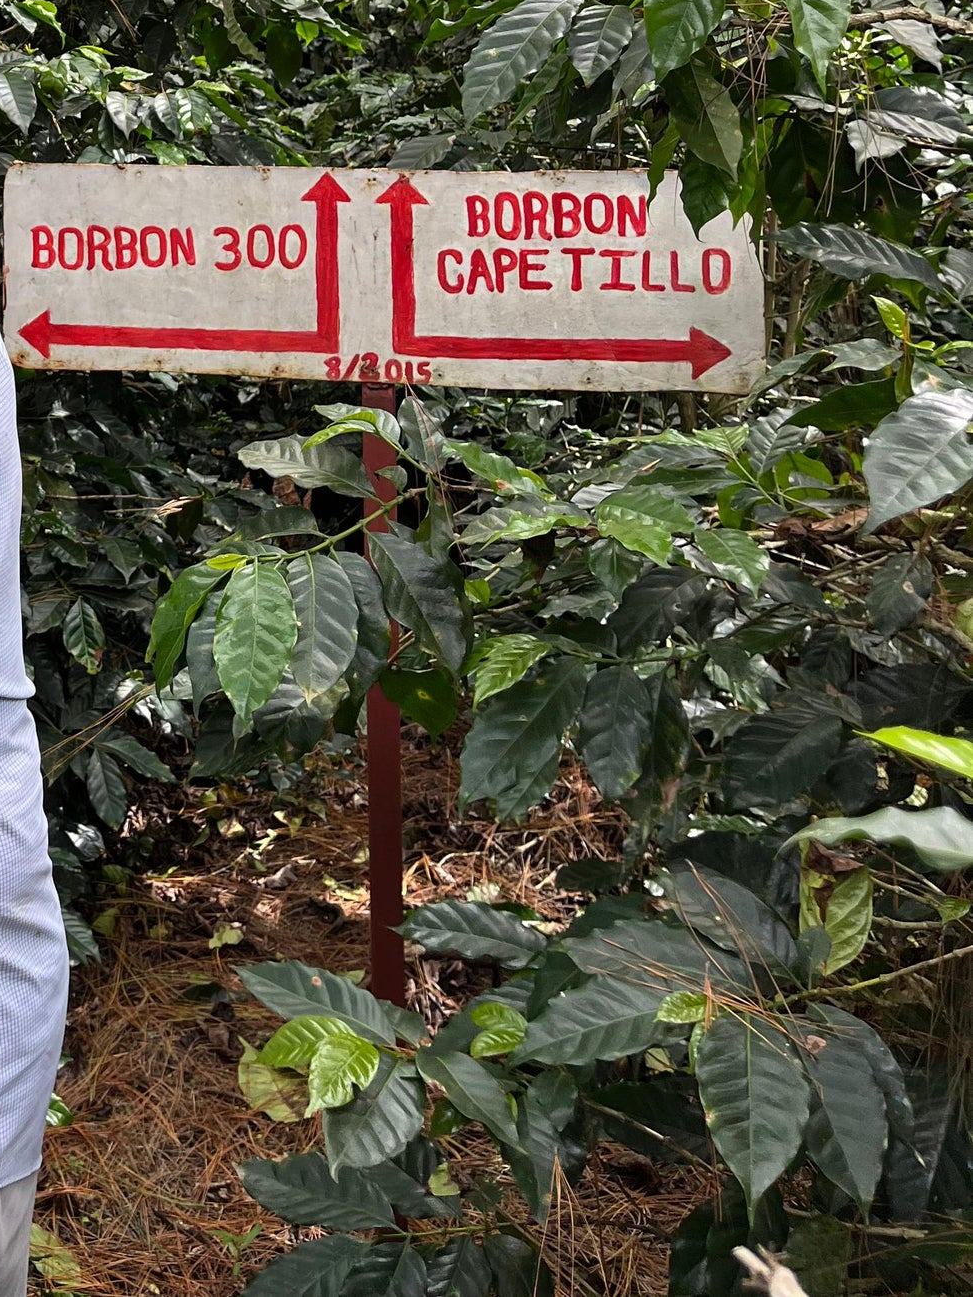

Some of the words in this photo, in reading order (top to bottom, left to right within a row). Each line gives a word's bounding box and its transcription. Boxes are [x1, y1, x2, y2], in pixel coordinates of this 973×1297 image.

[466, 191, 647, 240] BORBON
[31, 225, 195, 272] BORBON
[214, 224, 308, 271] 300
[437, 247, 731, 295] CAPETILLO
